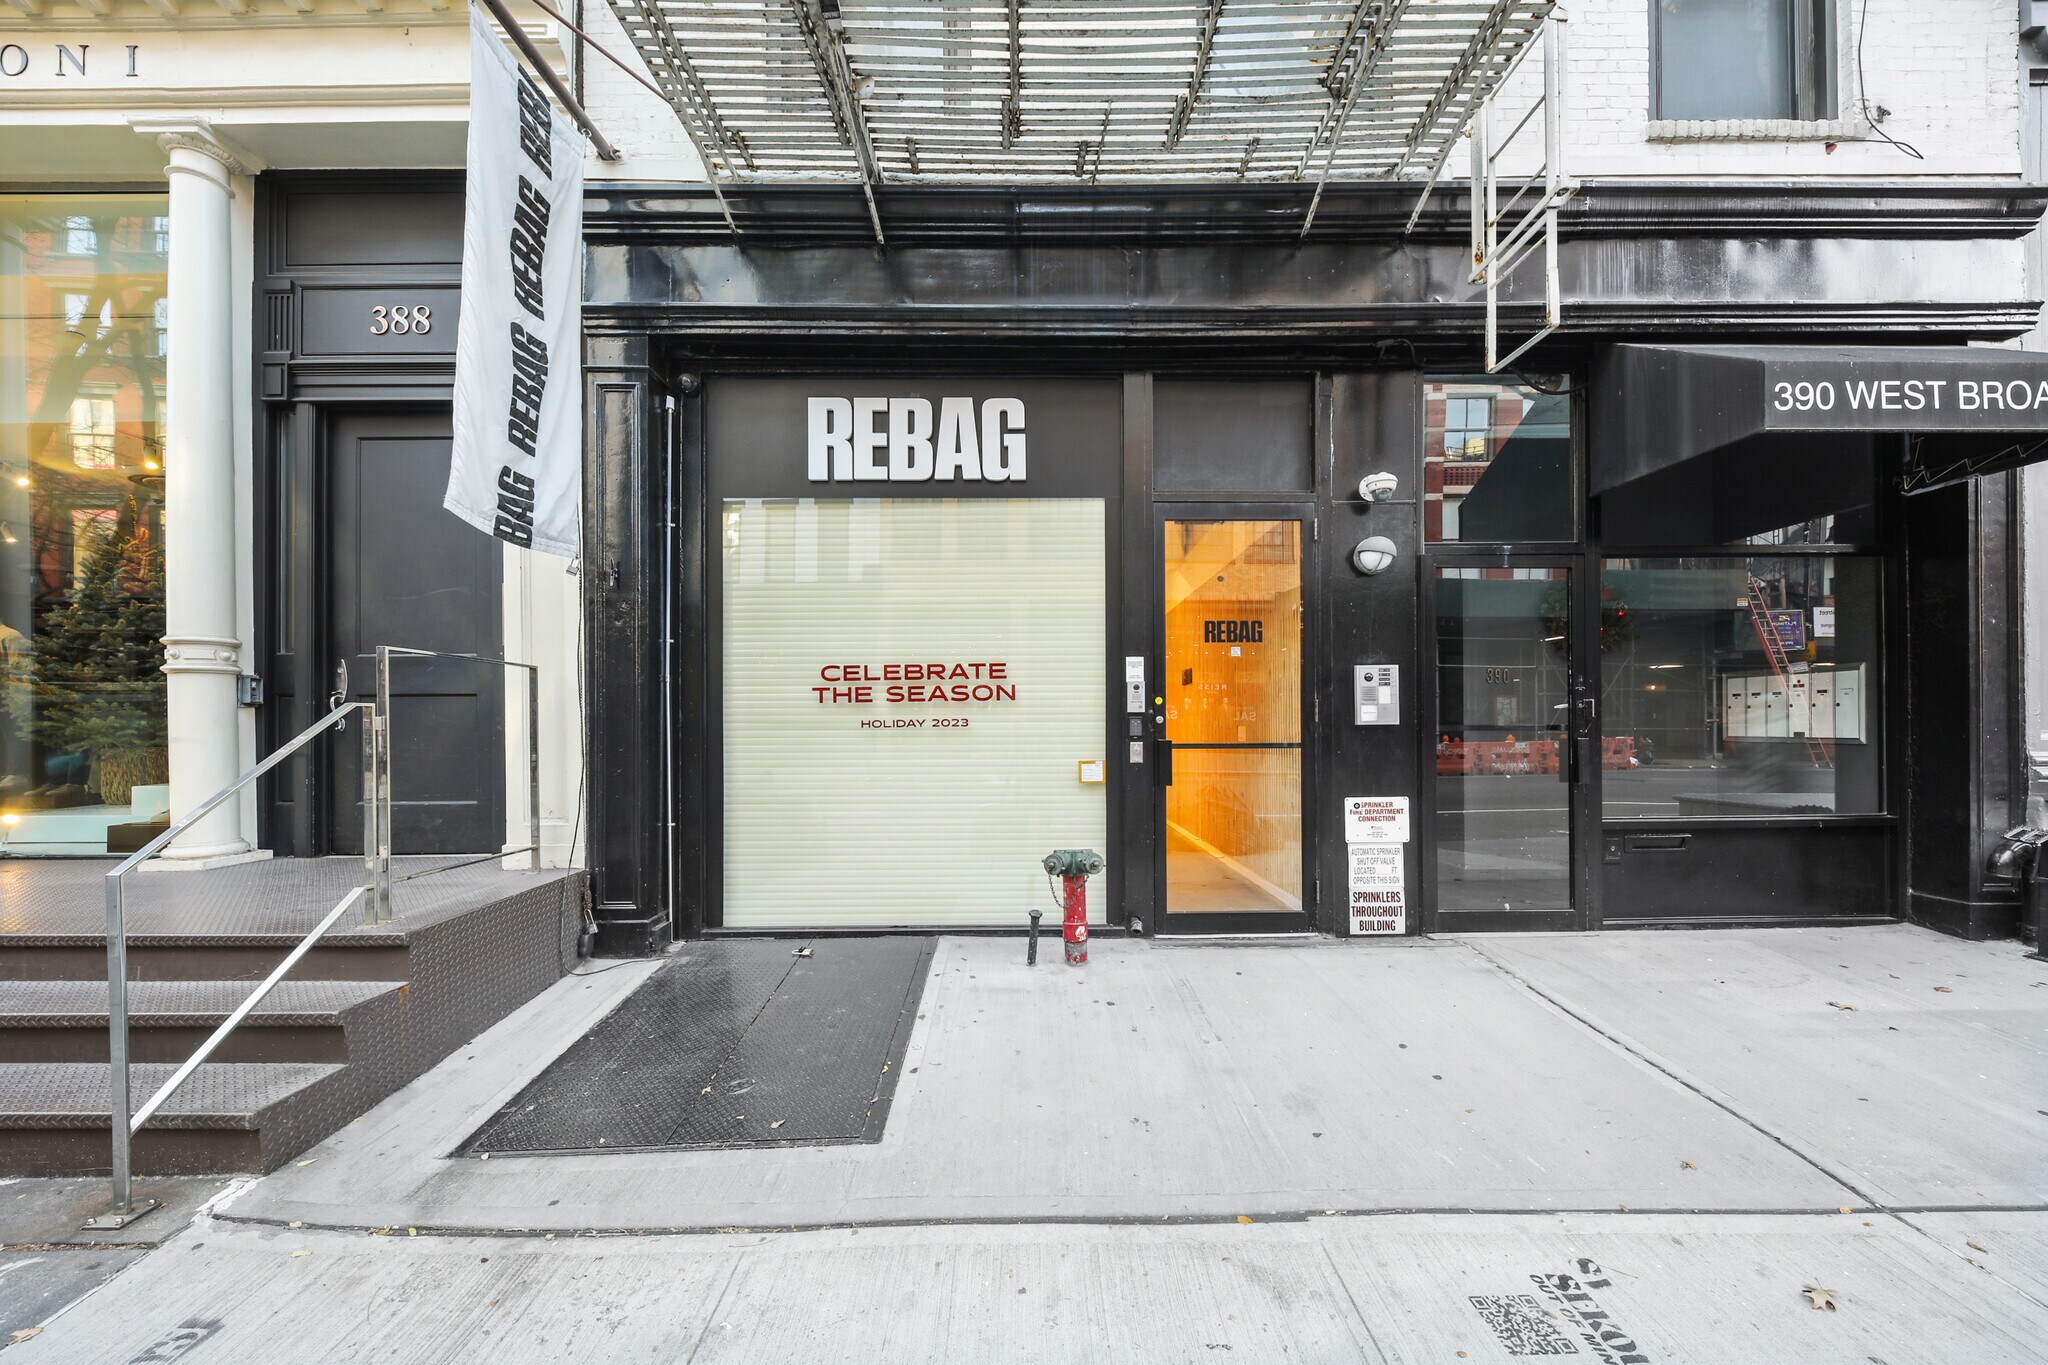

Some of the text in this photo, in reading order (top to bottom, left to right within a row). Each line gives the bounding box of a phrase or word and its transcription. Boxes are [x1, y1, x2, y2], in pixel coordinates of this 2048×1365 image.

[510, 174, 551, 321] REBAG
[370, 305, 431, 335] 388
[508, 321, 549, 458] REBAG
[1773, 380, 2048, 410] 390 WEST BROA
[807, 396, 1027, 481] REBAG
[493, 465, 535, 549] BAG
[1204, 620, 1263, 643] REBAG
[820, 663, 1008, 682] CELEBRATE
[1486, 668, 1510, 684] 390
[812, 684, 1016, 703] THE SEASON
[861, 718, 969, 728] HOLIDAY 2023
[1351, 847, 1401, 856] AUTOMATIC SPRINKLER
[1357, 857, 1395, 865] SHUT OFF VALVE
[1353, 876, 1400, 884] OPPOSITE THIS SIGN
[1354, 866, 1376, 875] LOCATED
[1352, 891, 1401, 903] SPRINKLERS
[1351, 905, 1403, 917] THROUGHOUT
[1359, 919, 1396, 931] BUILDING
[1529, 1274, 1564, 1304] OUT
[1559, 1308, 1586, 1328] OF
